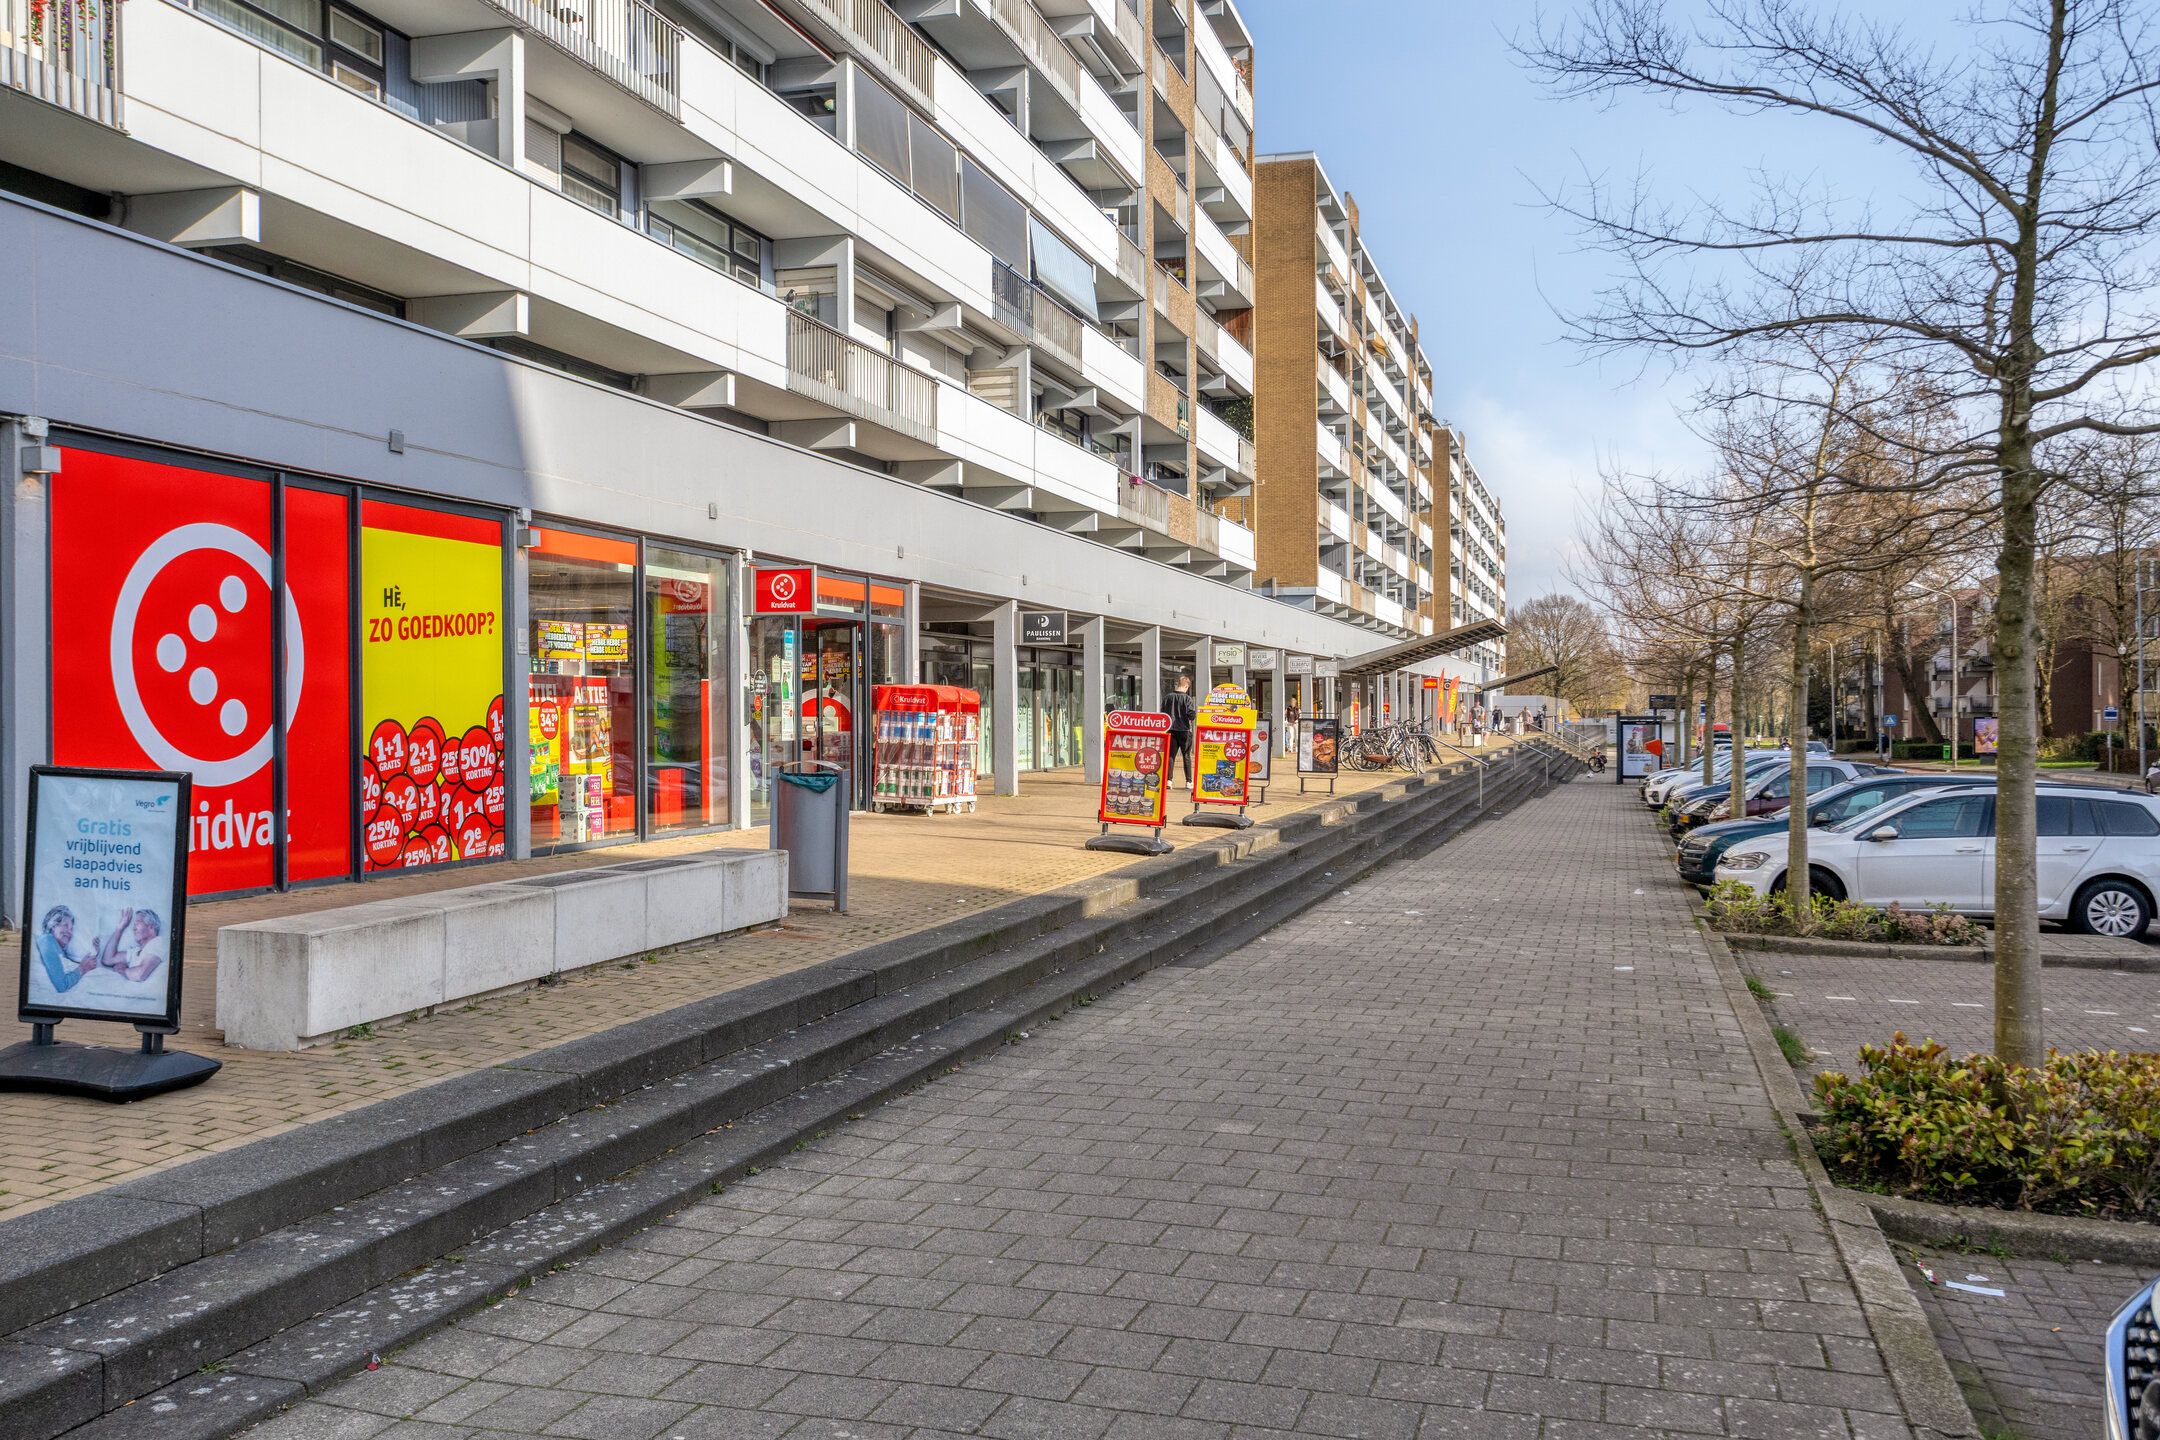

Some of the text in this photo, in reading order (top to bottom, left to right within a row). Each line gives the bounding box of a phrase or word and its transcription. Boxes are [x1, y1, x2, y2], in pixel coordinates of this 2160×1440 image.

[384, 585, 406, 611] HÈ,
[770, 601, 796, 609] Kruidvat
[369, 611, 495, 643] ZO GOEDKOOP?
[574, 685, 608, 704] ACTIE!
[899, 695, 926, 704] Kruidvat
[540, 713, 558, 727] 34.99
[1122, 715, 1167, 728] Kruidvat
[1218, 716, 1242, 724] Kruidvat
[1112, 734, 1161, 751] ACTIE!
[1204, 730, 1247, 743] ACTIE!
[374, 733, 404, 762] 1+1
[409, 739, 437, 767] 2+1
[379, 759, 401, 772] GRATIS
[460, 744, 495, 770] 50%
[1138, 752, 1158, 765] 1+1
[413, 763, 434, 775] GRATIS
[445, 767, 459, 776] KORT
[465, 767, 493, 780] KORTING
[135, 799, 155, 809] Vegro
[385, 785, 417, 811] 3+2
[420, 783, 436, 809] +1
[189, 798, 292, 853] idva
[402, 811, 413, 823] TIS
[77, 817, 132, 837] Gratis
[368, 818, 400, 842] 25%
[66, 838, 142, 856] vrijblijvend
[372, 839, 397, 851] KORTING
[432, 835, 448, 860] +2
[63, 856, 143, 874] slaapadvies
[405, 847, 431, 867] 25%
[74, 877, 131, 891] aan huis
